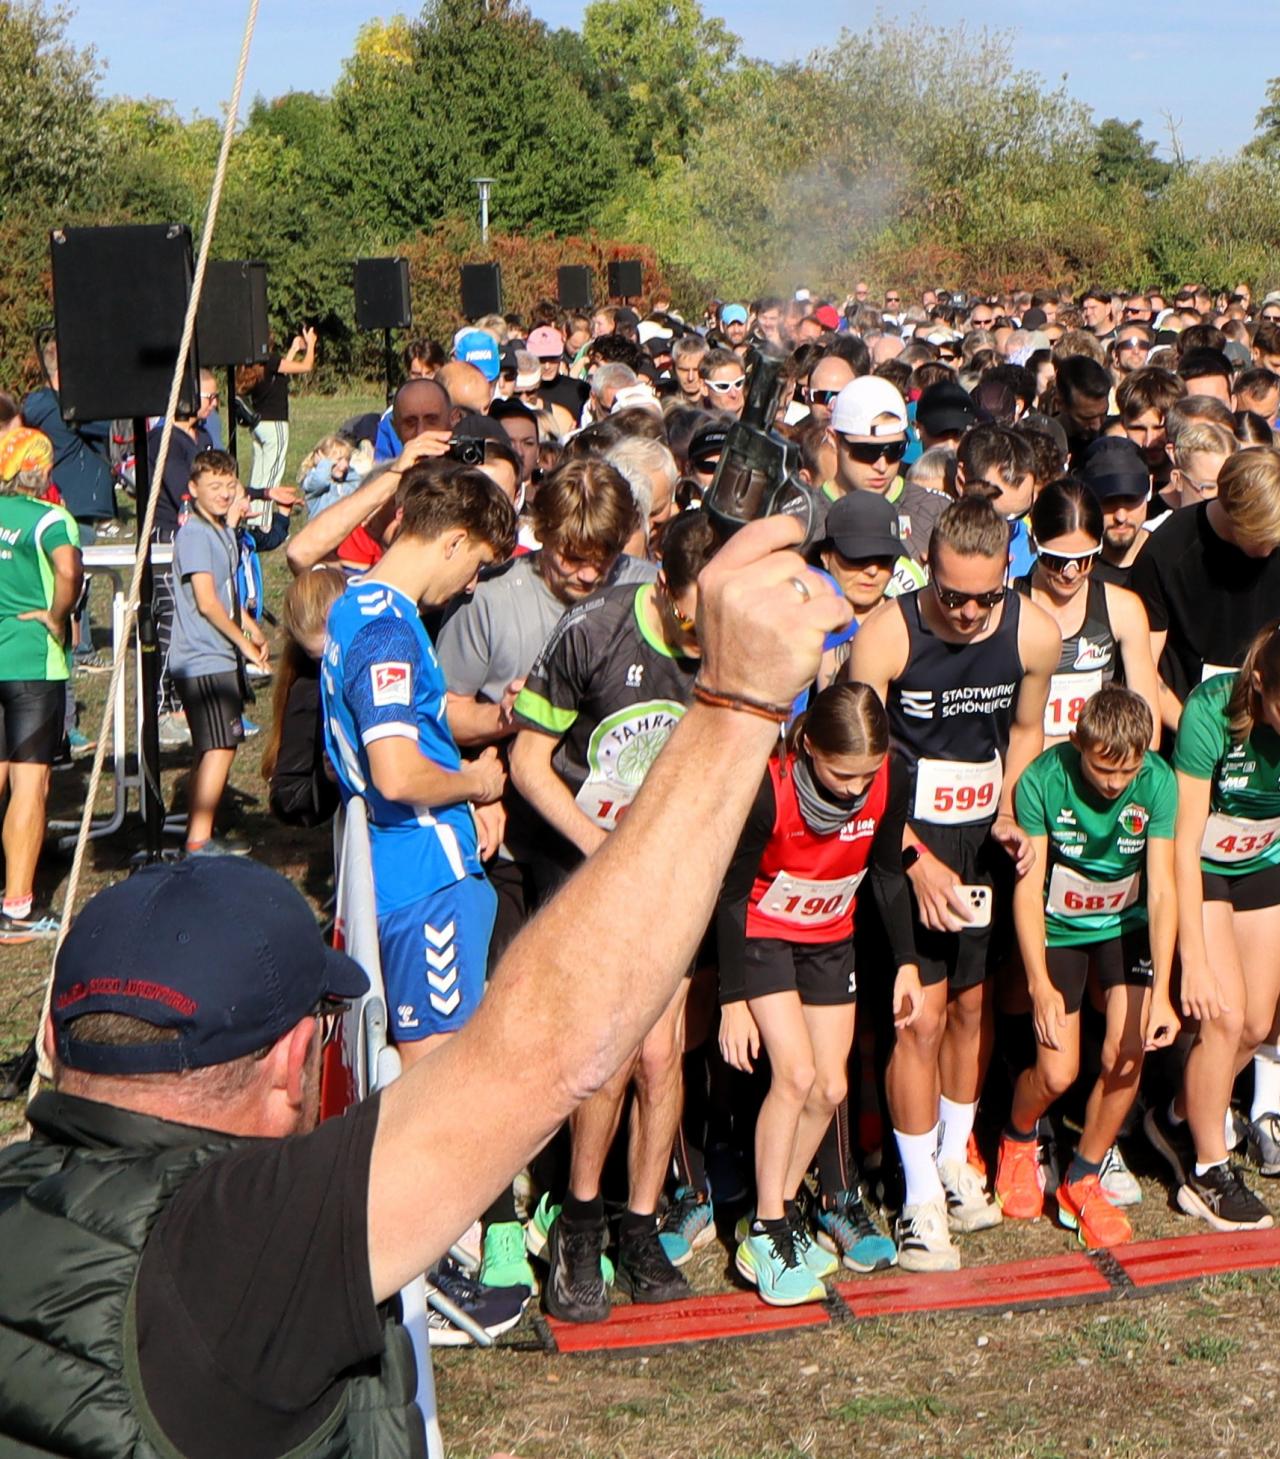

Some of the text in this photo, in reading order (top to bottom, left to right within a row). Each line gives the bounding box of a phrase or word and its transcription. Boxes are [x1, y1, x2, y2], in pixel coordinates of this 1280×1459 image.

[933, 782, 994, 812] 599
[1216, 831, 1275, 854] 433
[784, 894, 843, 916] 190
[1064, 890, 1126, 911] 687
